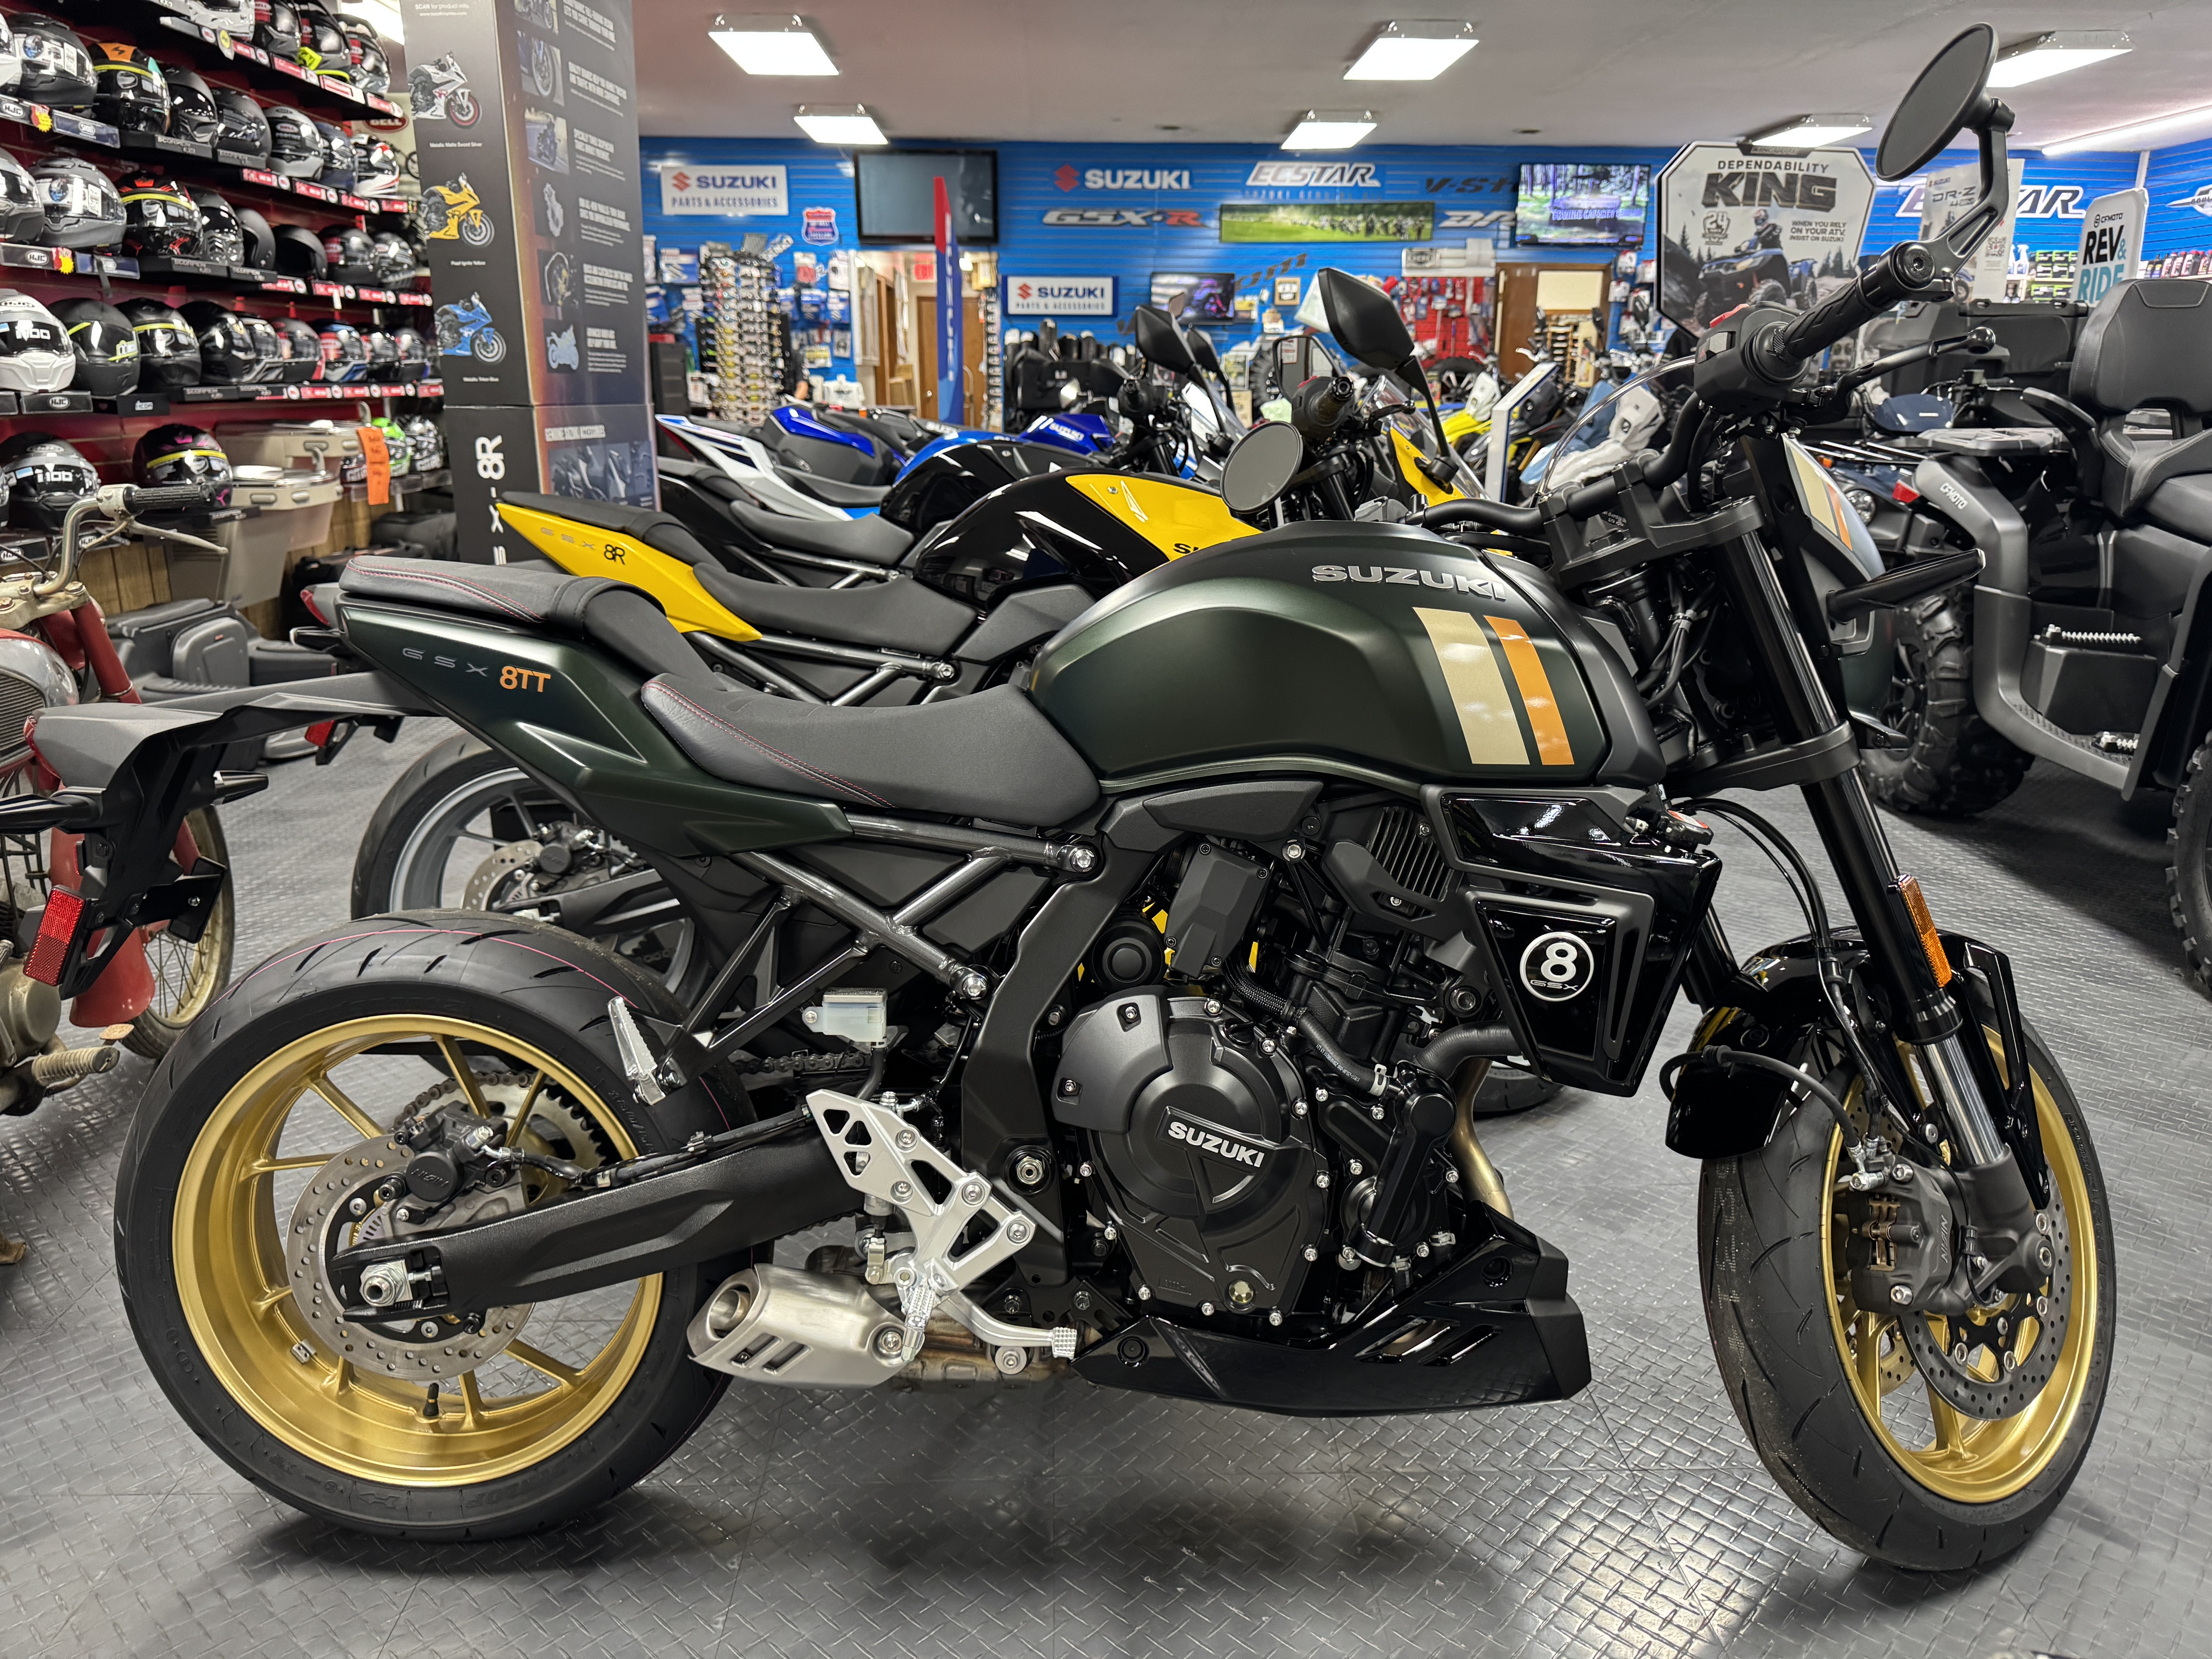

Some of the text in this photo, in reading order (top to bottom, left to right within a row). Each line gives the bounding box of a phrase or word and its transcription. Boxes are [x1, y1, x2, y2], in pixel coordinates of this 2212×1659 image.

[1246, 161, 1381, 187] ECSTAR
[1718, 160, 1829, 173] DEPENDABILITY
[696, 176, 777, 189] SUZUKI
[1084, 169, 1191, 190] SUZUKI
[672, 197, 778, 208] PARTS & ACCESSORIES
[1701, 172, 1837, 212] KING
[1042, 208, 1209, 228] GSX-R
[2101, 213, 2124, 223] CFMOTO
[2083, 225, 2126, 266] REV &
[29, 254, 45, 262] HJC
[1037, 287, 1104, 299] SUZUKI
[1940, 483, 1968, 510] CFMOTO
[603, 544, 626, 565] 8R
[1312, 565, 1506, 601] SUZUKI
[500, 665, 551, 693] 8TT
[1540, 941, 1578, 982] 8
[1530, 979, 1579, 991] GSX
[1168, 1121, 1265, 1168] SUZUKI
